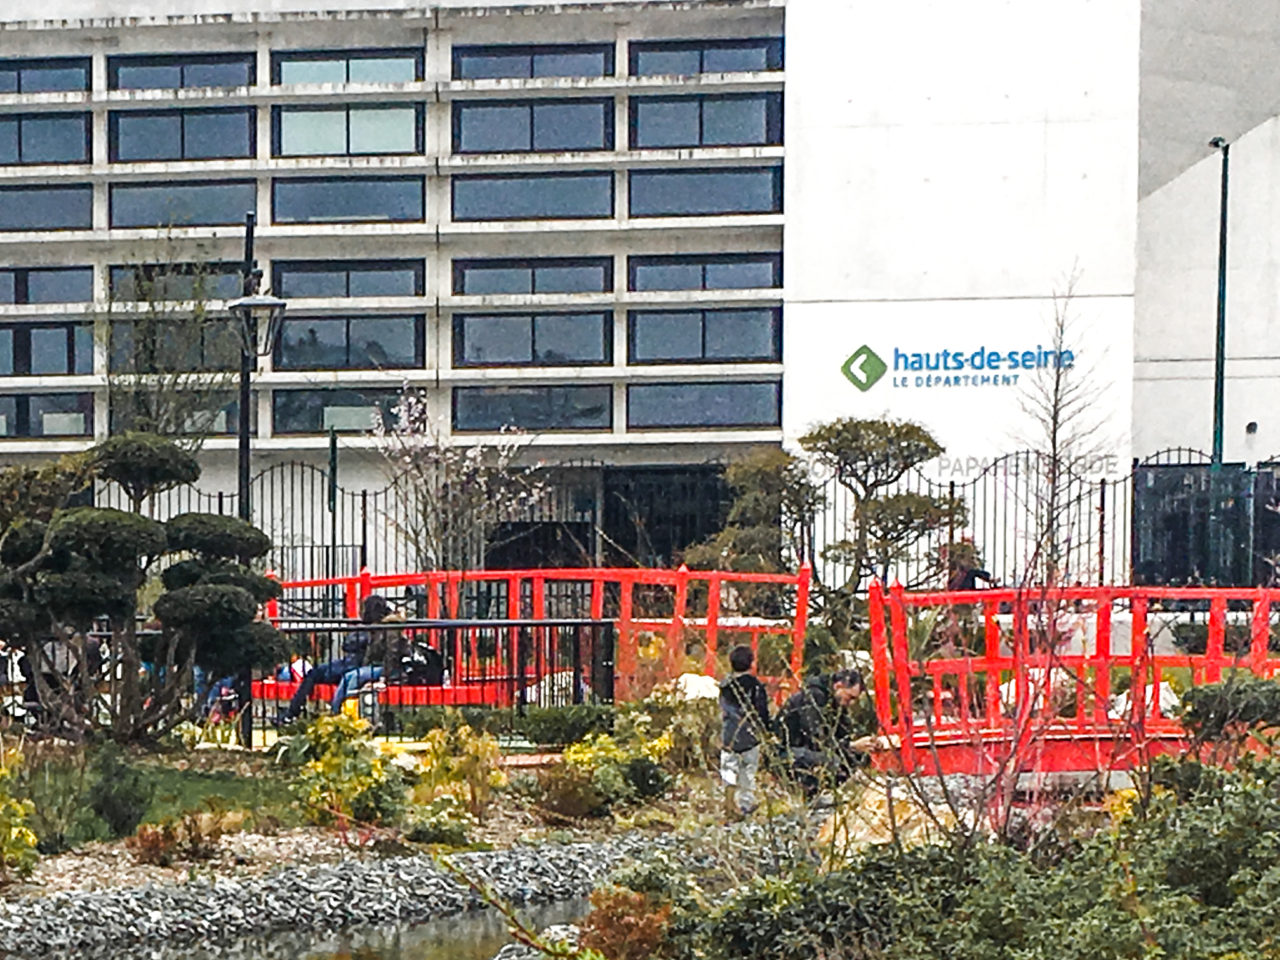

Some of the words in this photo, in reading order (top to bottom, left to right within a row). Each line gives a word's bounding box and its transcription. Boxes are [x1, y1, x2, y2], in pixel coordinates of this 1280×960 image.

[893, 345, 1074, 371] hauts-de-seine
[893, 376, 908, 388] LE
[915, 374, 1020, 388] DÉPARTEMENT
[937, 455, 1119, 477] PAPAEDE
